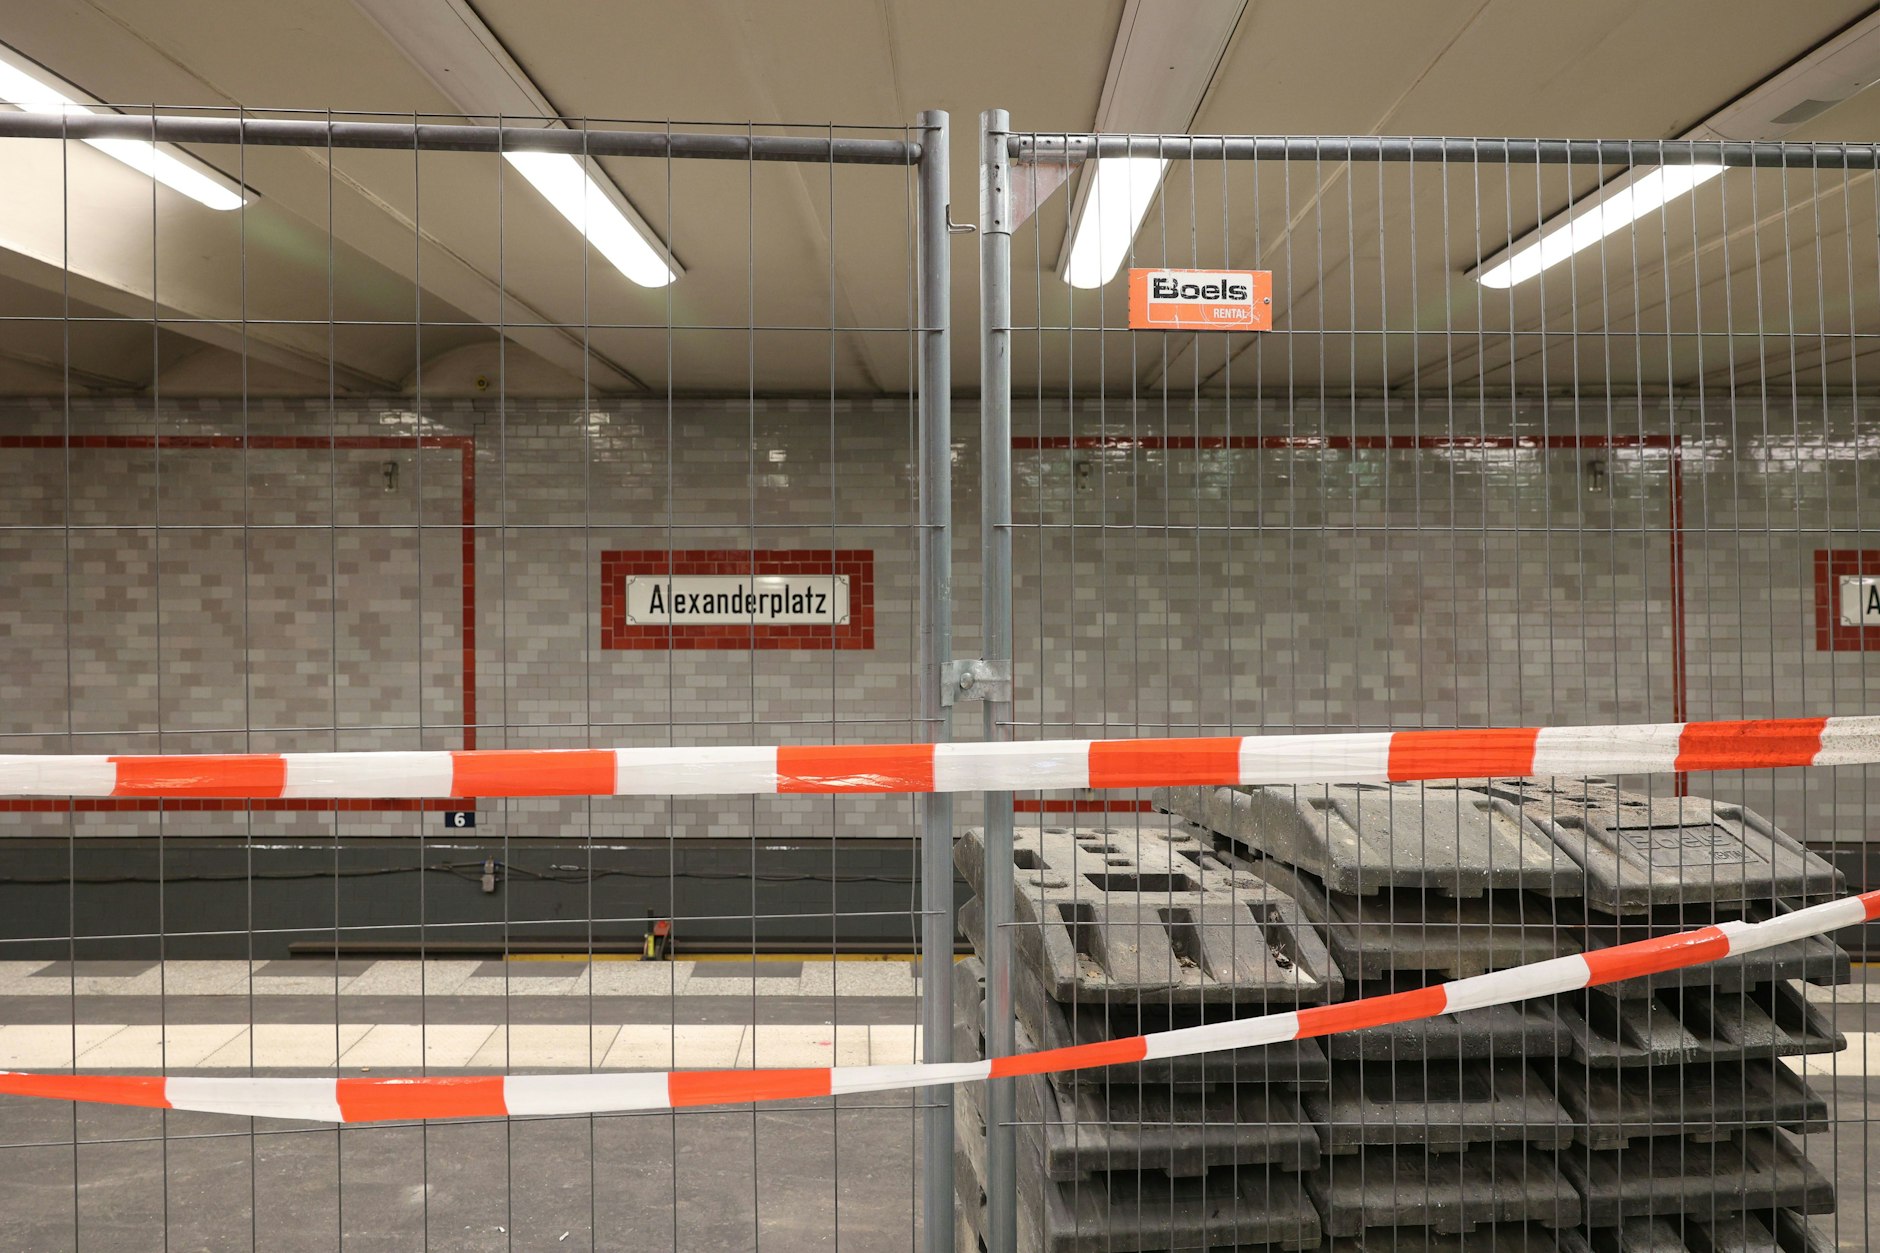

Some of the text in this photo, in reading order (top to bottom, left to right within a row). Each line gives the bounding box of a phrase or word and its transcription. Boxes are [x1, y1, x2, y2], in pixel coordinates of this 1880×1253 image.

[1153, 277, 1248, 301] Boels
[1213, 308, 1248, 319] RENTAL
[649, 583, 827, 618] Alexanderplatz
[454, 812, 466, 827] 6
